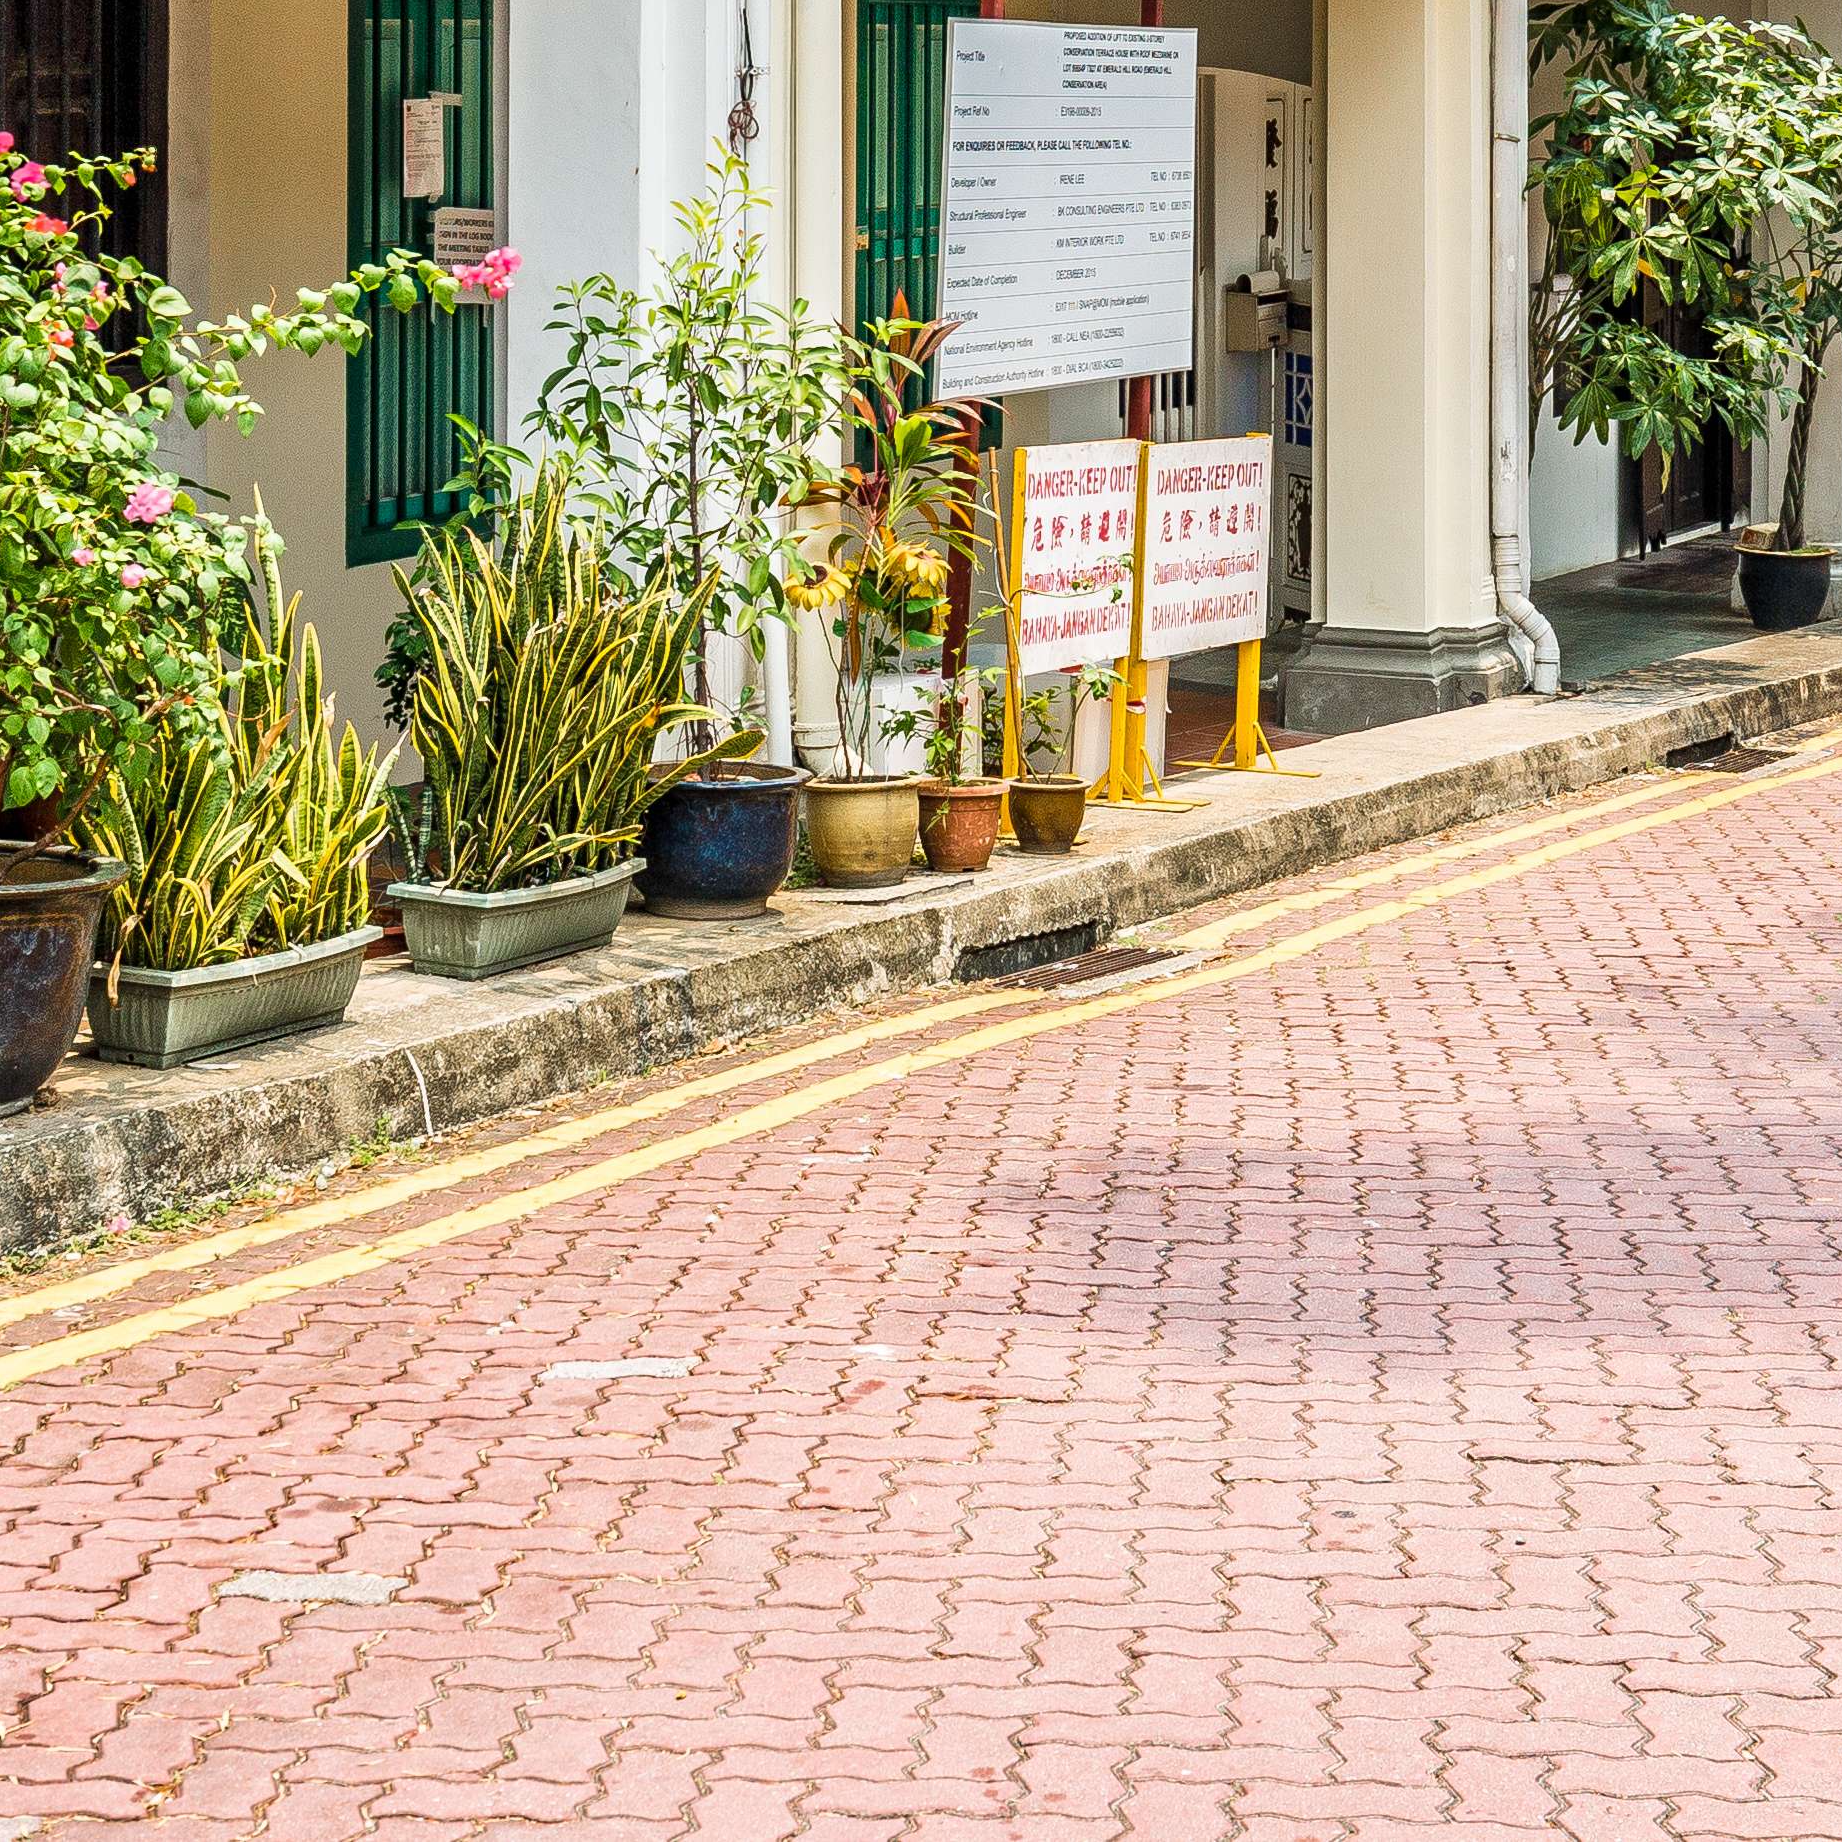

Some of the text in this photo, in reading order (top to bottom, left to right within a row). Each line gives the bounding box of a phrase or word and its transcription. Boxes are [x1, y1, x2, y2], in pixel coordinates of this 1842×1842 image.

[956, 51, 985, 63] Project Title
[1063, 47, 1094, 56] CONSERVATION
[1096, 48, 1114, 57] TERRACE
[1115, 49, 1129, 57] HOUSE
[1103, 65, 1121, 74] EMERALD
[1063, 80, 1094, 89] CONSERVATION
[954, 105, 972, 118] Project
[952, 141, 965, 151] FOR
[966, 141, 995, 151] ENQUIRIES
[1006, 140, 1036, 152] FEEDBACK,
[1037, 140, 1057, 150] PLEASE
[1058, 140, 1071, 150] CALL
[1072, 140, 1082, 150] THE
[1083, 140, 1111, 150] FOLLOWING
[951, 177, 976, 190] Developer
[980, 176, 997, 187] Owner
[950, 208, 1027, 221] Structural Professional Engineer
[1065, 205, 1096, 216] CONSULTING
[1098, 203, 1124, 214] ENGINEERS
[1065, 237, 1088, 247] INTERIOR
[948, 244, 966, 255] Builder
[1056, 269, 1083, 280] DECEMBER
[946, 277, 970, 290] Expected
[971, 276, 983, 287] Date
[990, 275, 1018, 287] Completion
[961, 310, 978, 320] Hotline
[943, 338, 1033, 356] National Environment Agency Hotline
[942, 379, 963, 390] Building
[974, 374, 1007, 385] Construction
[1007, 371, 1026, 382] Authority
[1027, 369, 1044, 379] Hotline
[1110, 465, 1137, 493] OUT!
[1237, 462, 1263, 488] OUT!
[1226, 590, 1258, 618] DEKAT!
[1097, 603, 1130, 633] DEKAT!
